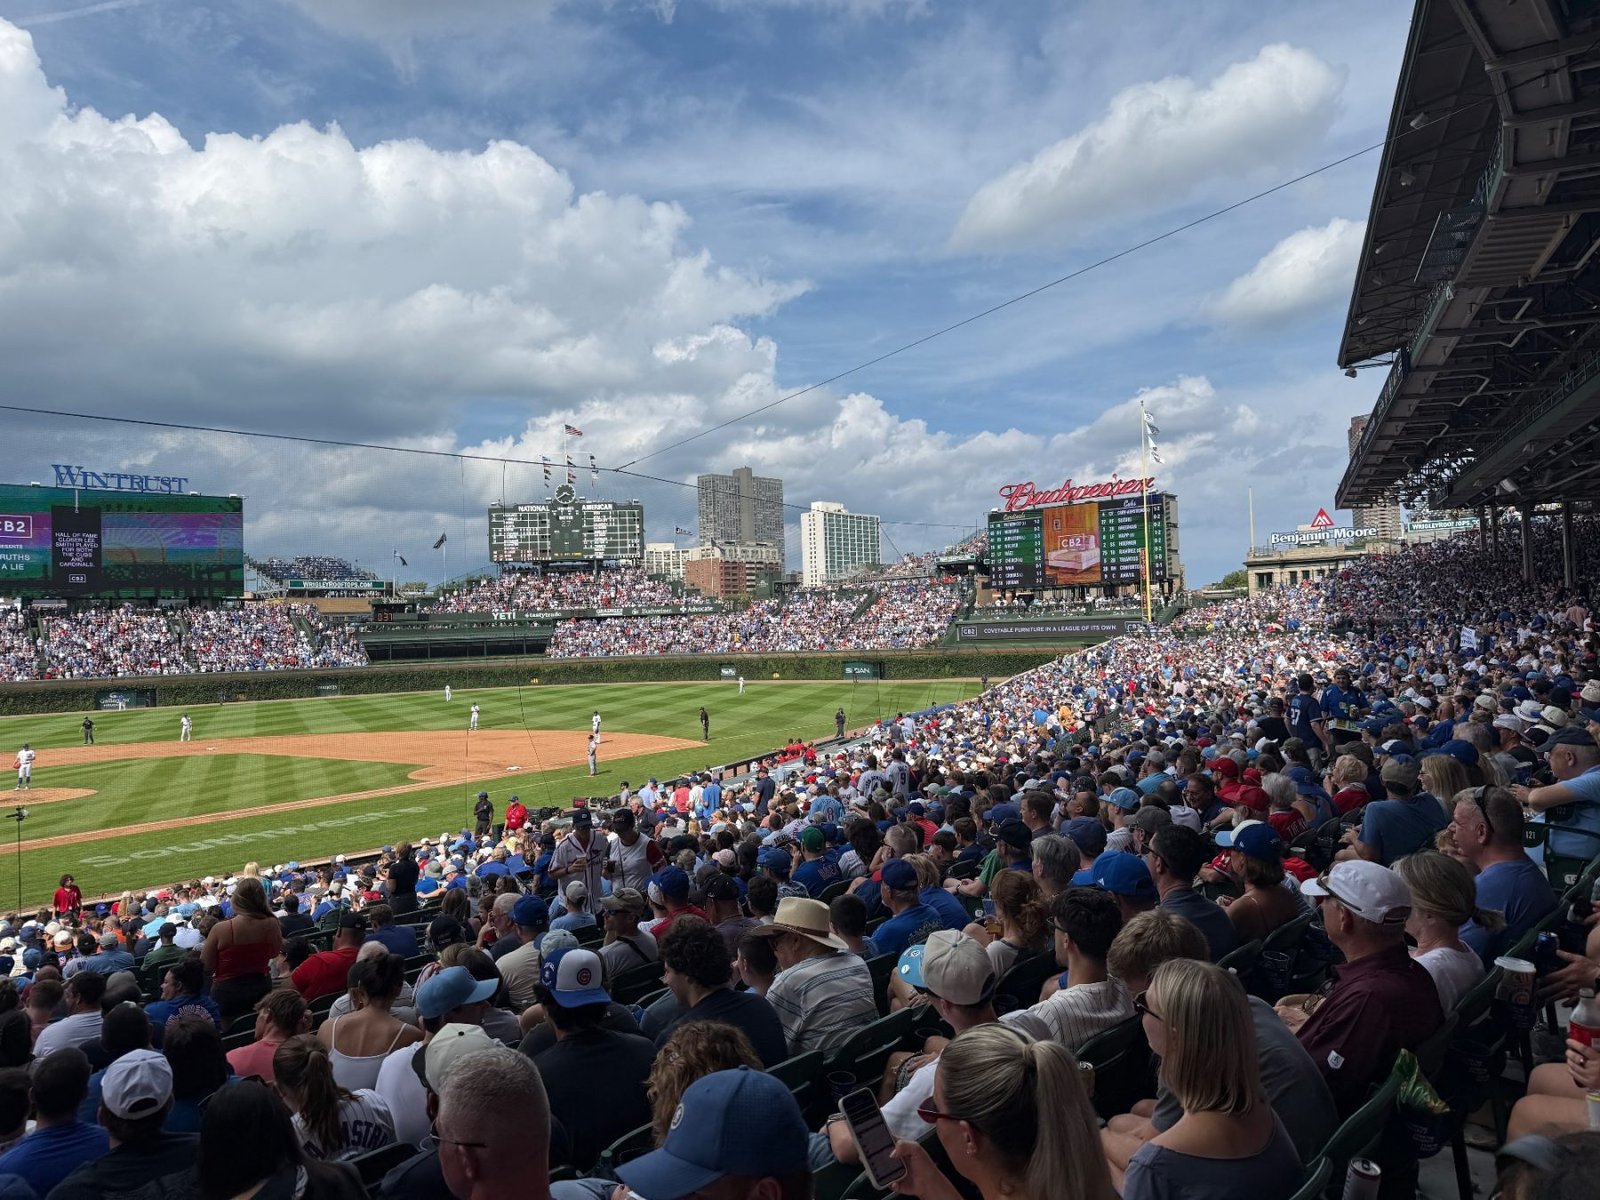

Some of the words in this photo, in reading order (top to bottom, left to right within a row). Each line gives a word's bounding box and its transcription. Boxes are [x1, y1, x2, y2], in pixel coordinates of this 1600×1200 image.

[999, 473, 1155, 511] Budweiser
[0, 520, 26, 532] B2
[1062, 538, 1080, 548] CB2
[1272, 530, 1329, 544] Benjamin
[1334, 528, 1377, 539] Moore
